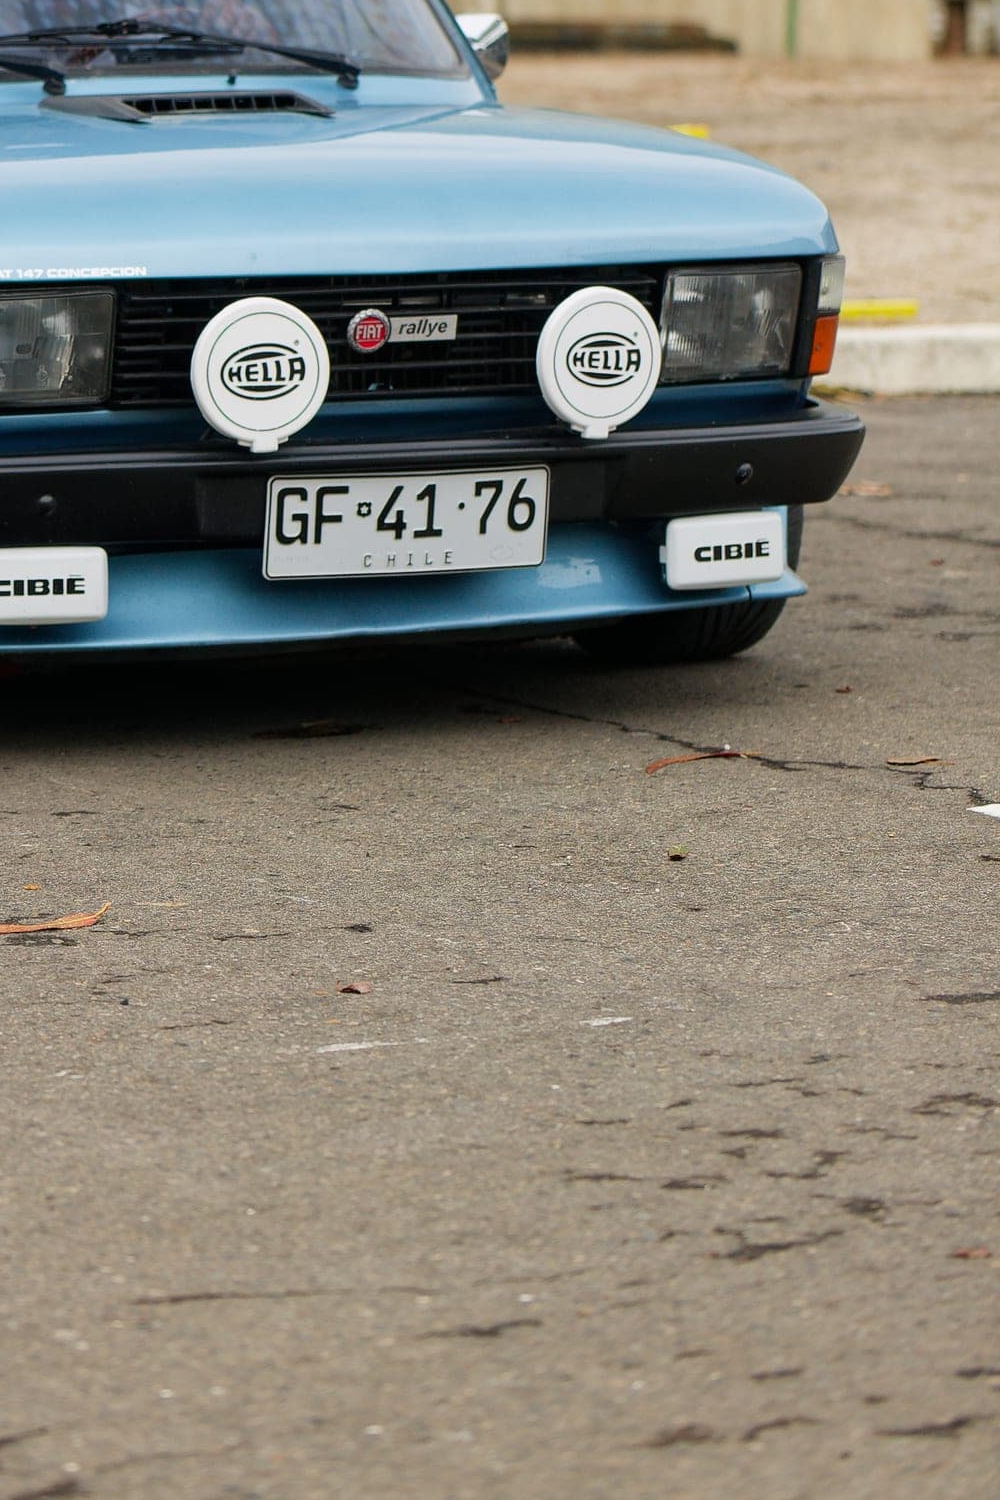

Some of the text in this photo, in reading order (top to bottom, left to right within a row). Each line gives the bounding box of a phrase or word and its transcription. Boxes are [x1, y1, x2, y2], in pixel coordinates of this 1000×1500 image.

[16, 268, 44, 279] 147
[46, 266, 147, 278] CONCEPCION
[355, 323, 384, 341] FIAT
[398, 319, 448, 338] rallye
[228, 356, 306, 382] HELLA
[573, 349, 641, 372] HELLA
[363, 551, 453, 568] CHILE
